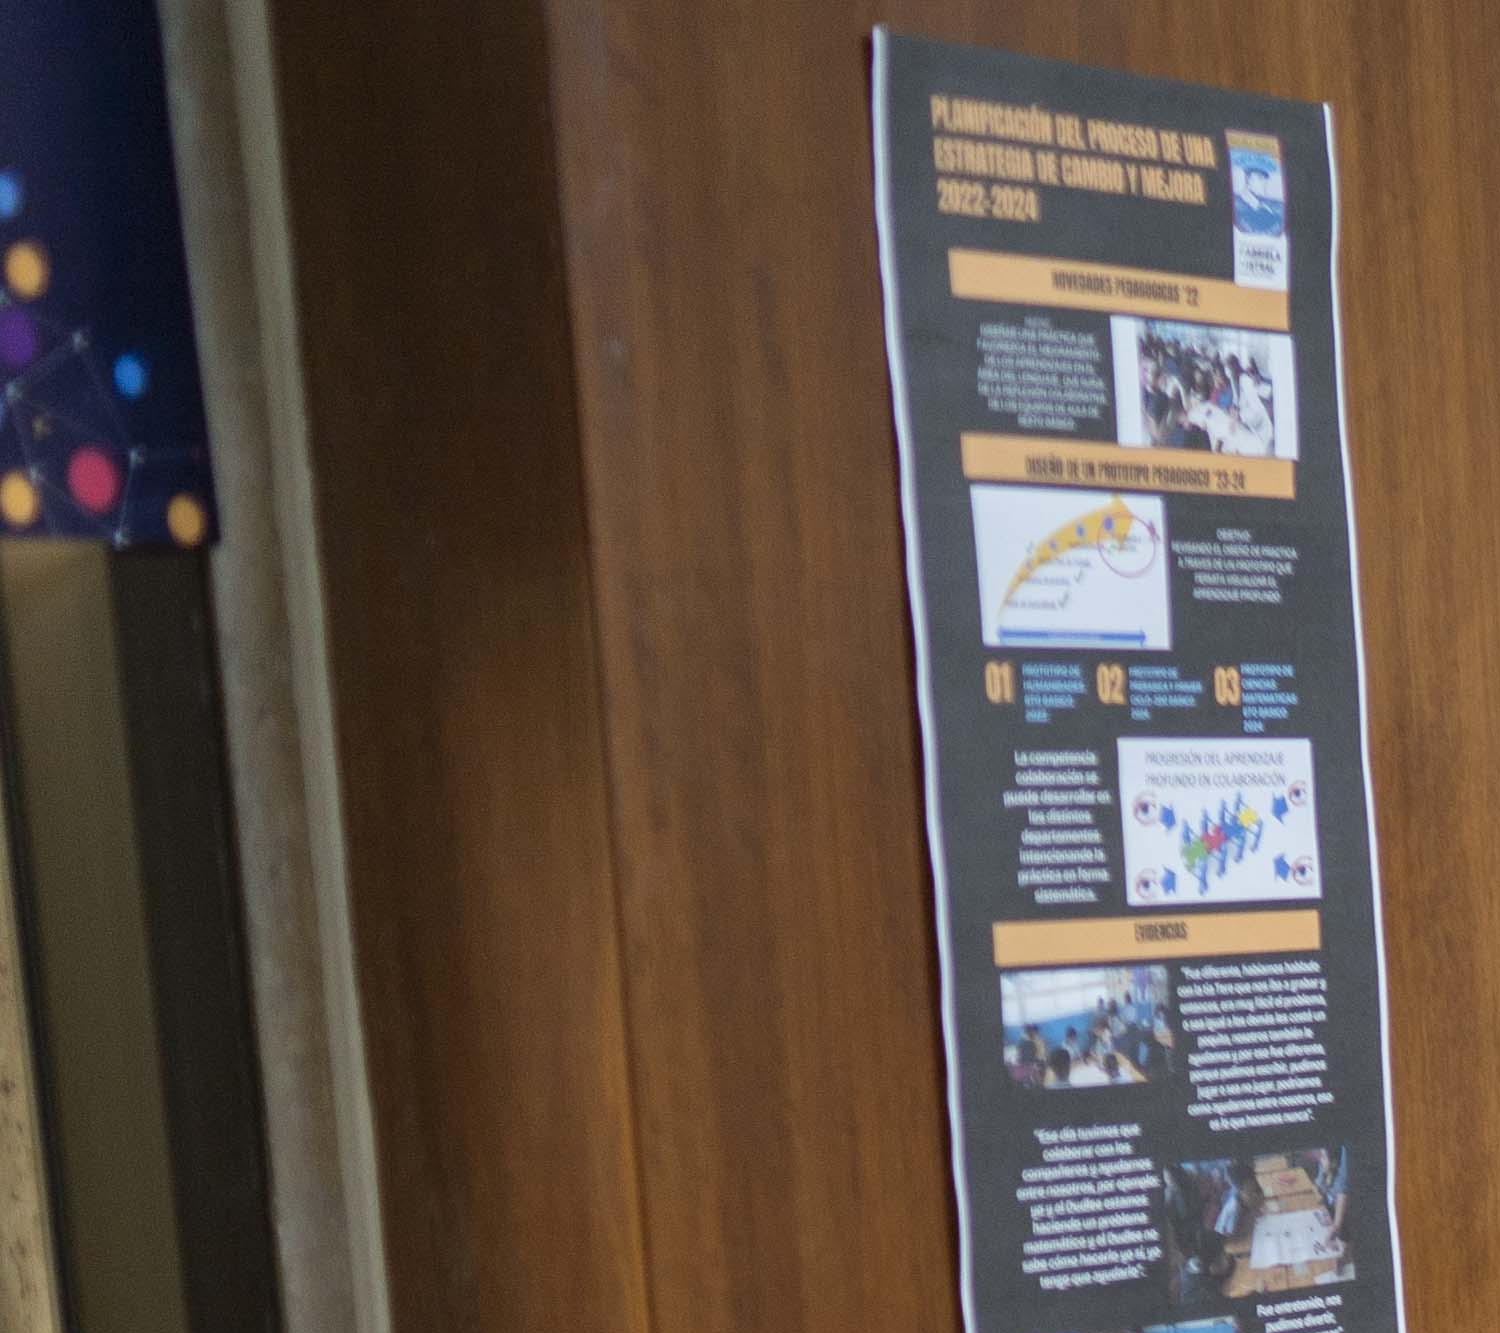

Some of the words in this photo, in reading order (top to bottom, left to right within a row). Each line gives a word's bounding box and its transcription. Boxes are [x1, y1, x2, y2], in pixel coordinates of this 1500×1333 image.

[1055, 112, 1084, 150] DEL
[1087, 117, 1158, 160] PROCESO
[1159, 128, 1183, 165] DE
[1036, 150, 1060, 186] DE
[1125, 161, 1139, 195] Y
[937, 177, 1040, 223] 2022-2024
[984, 661, 1016, 704] 01
[1096, 662, 1128, 706] 02
[1214, 665, 1242, 706] 03
[1015, 749, 1027, 765] La
[1029, 750, 1098, 768] competencia
[1145, 749, 1201, 766] PROGRESIÓN
[1203, 751, 1222, 766] DEL
[1224, 751, 1284, 766] APRENDIZAJE
[1015, 769, 1083, 785] colaboración
[1144, 771, 1197, 787] PROFUNDO
[1199, 772, 1211, 787] EN
[1212, 770, 1287, 787] COLABORACIÓN
[1002, 790, 1039, 808] puede
[1040, 789, 1096, 805] desarrollar
[1017, 867, 1062, 888] práctica
[1134, 921, 1187, 943] EVIDENCIAS
